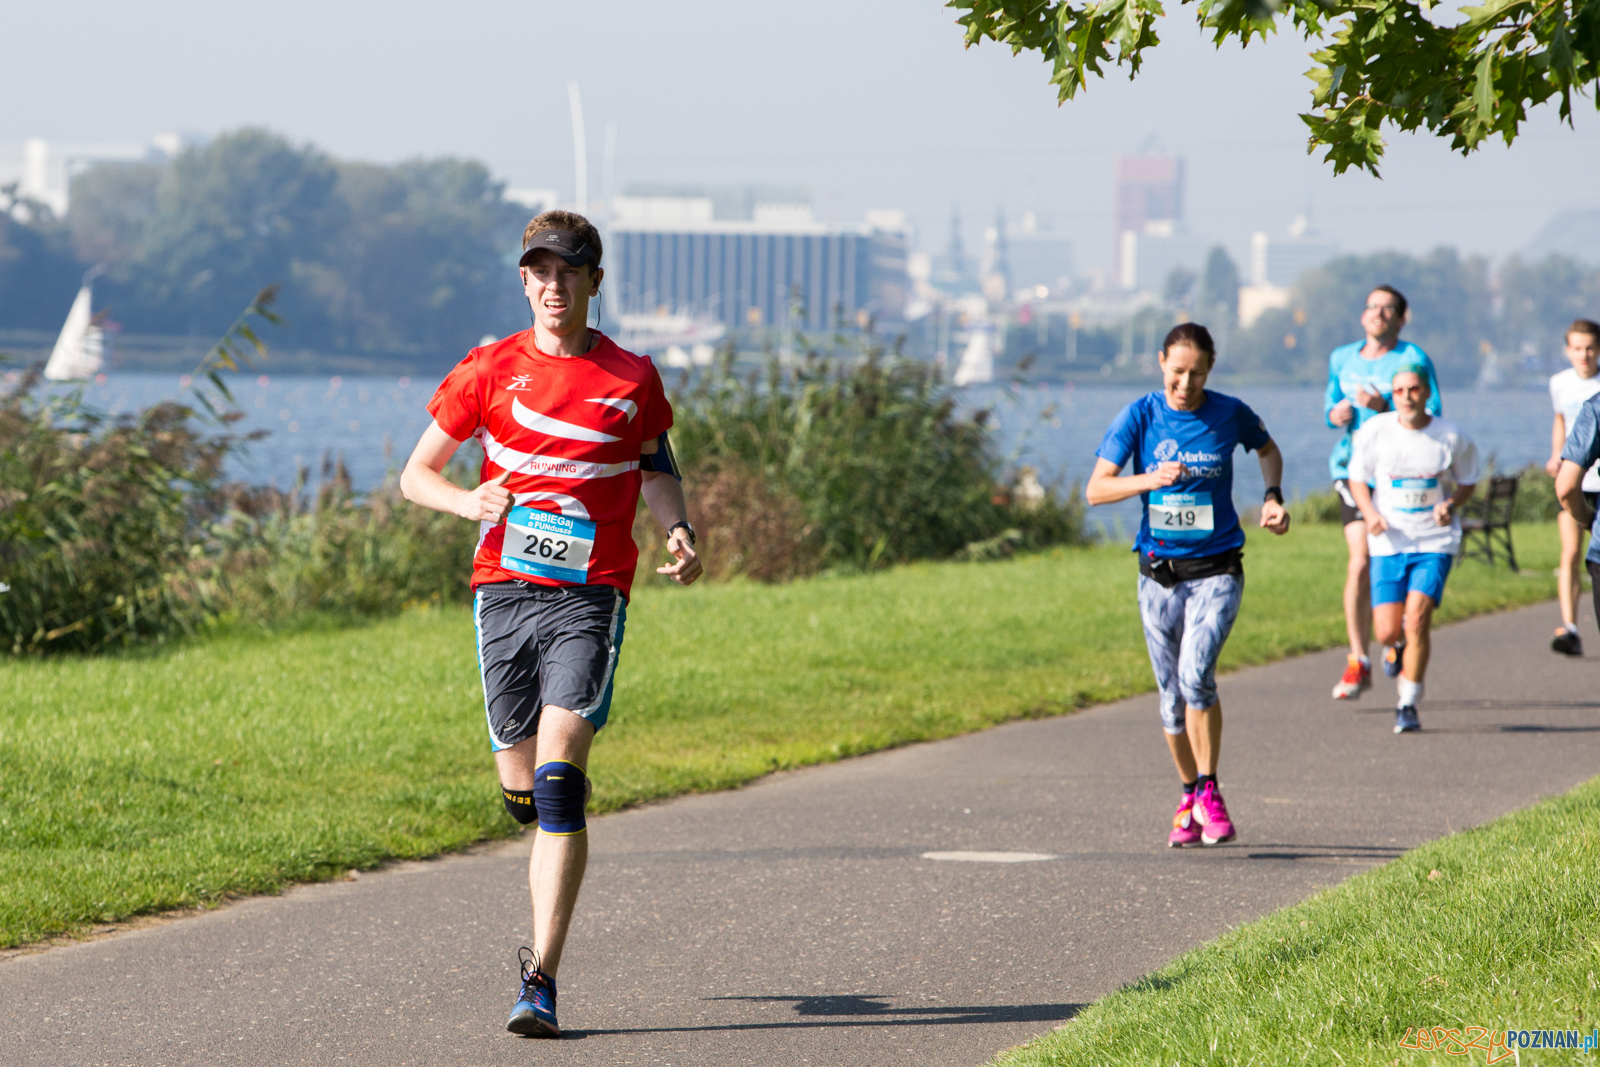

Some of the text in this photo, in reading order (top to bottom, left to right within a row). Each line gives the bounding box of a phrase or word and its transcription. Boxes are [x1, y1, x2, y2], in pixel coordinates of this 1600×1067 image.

[530, 461, 577, 473] RUNNING
[528, 511, 574, 530] zaBIEGaj
[1165, 510, 1196, 526] 219
[523, 534, 569, 561] 262
